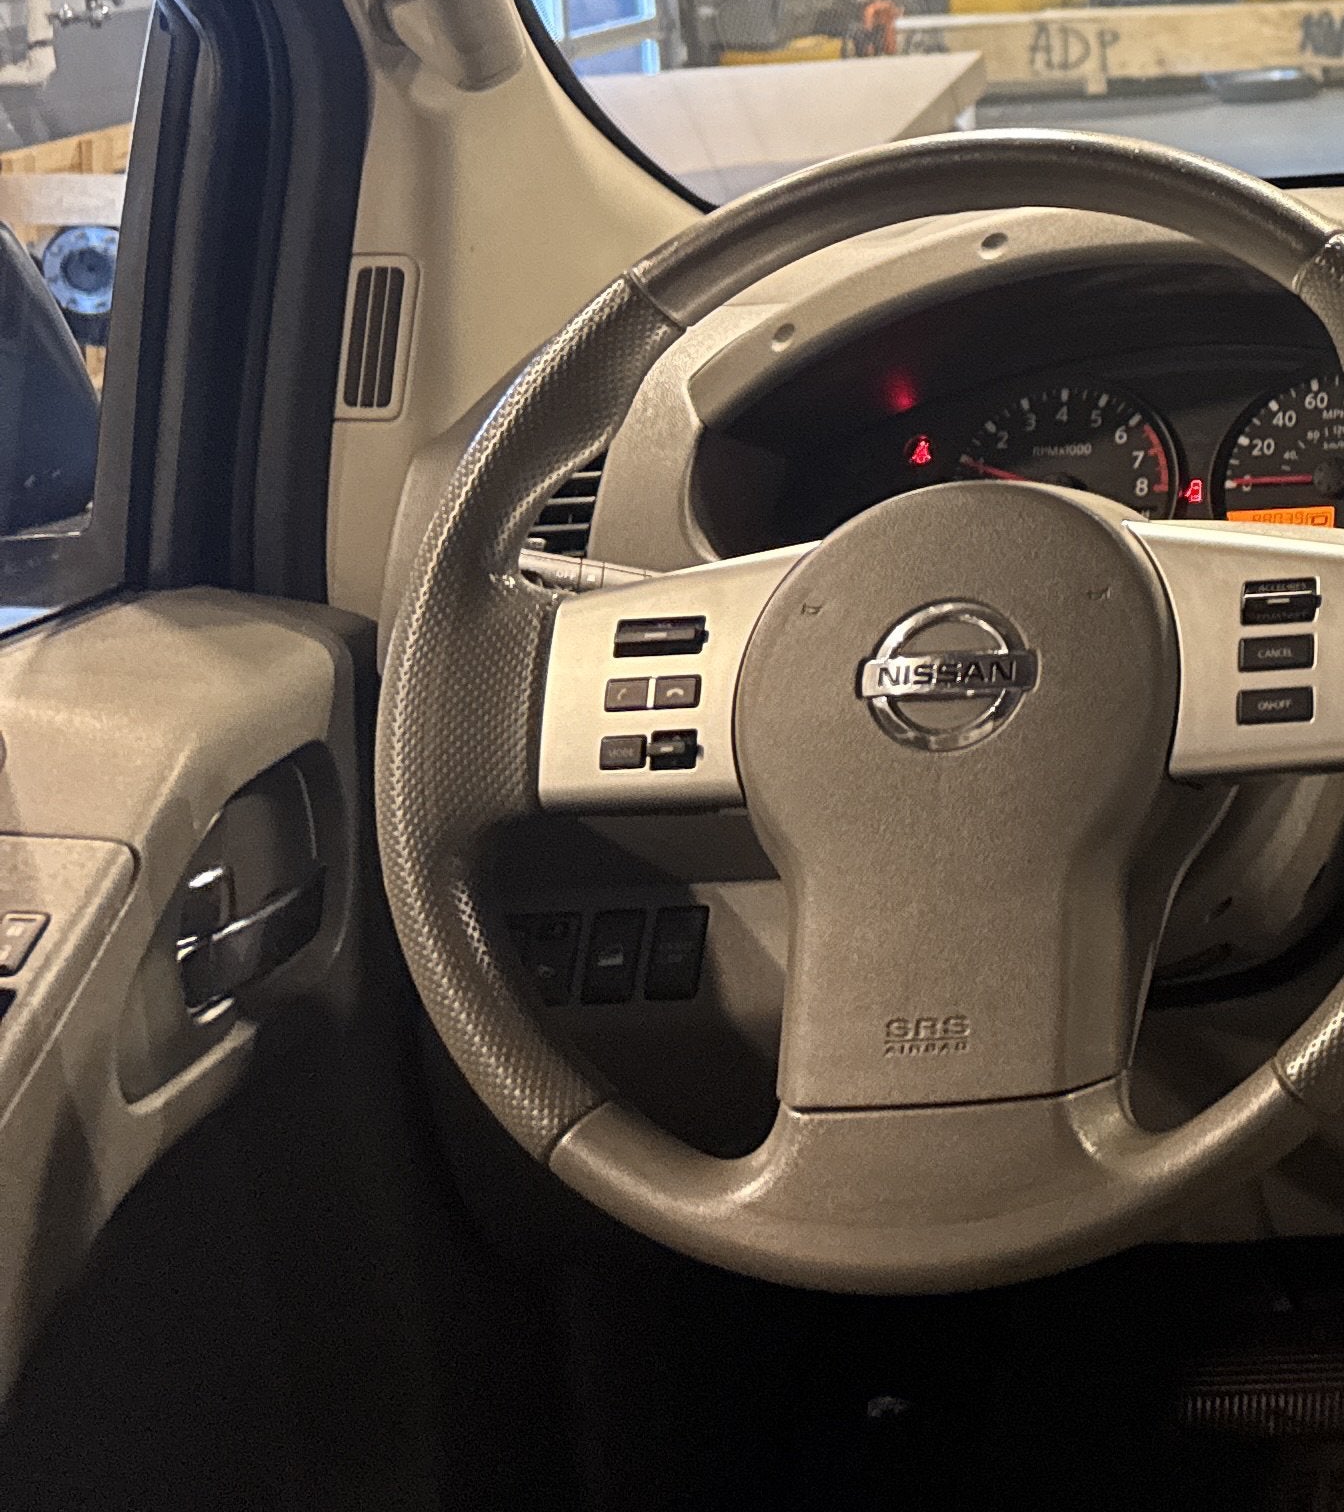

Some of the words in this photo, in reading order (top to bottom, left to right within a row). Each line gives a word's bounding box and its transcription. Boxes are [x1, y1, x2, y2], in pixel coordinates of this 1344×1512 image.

[1028, 19, 1120, 73] ADP
[1304, 391, 1329, 410] 60
[1025, 413, 1037, 431] 3
[1056, 405, 1069, 423] 4
[1090, 409, 1103, 428] 5
[1272, 410, 1297, 428] 40
[996, 431, 1009, 449] 2
[1114, 425, 1128, 445] 6
[1251, 438, 1276, 457] 20
[1131, 450, 1145, 469] 7
[1135, 478, 1149, 497] 8
[1256, 647, 1294, 660] CANCEL
[875, 657, 1018, 690] NISSAN
[884, 1013, 971, 1040] SRS
